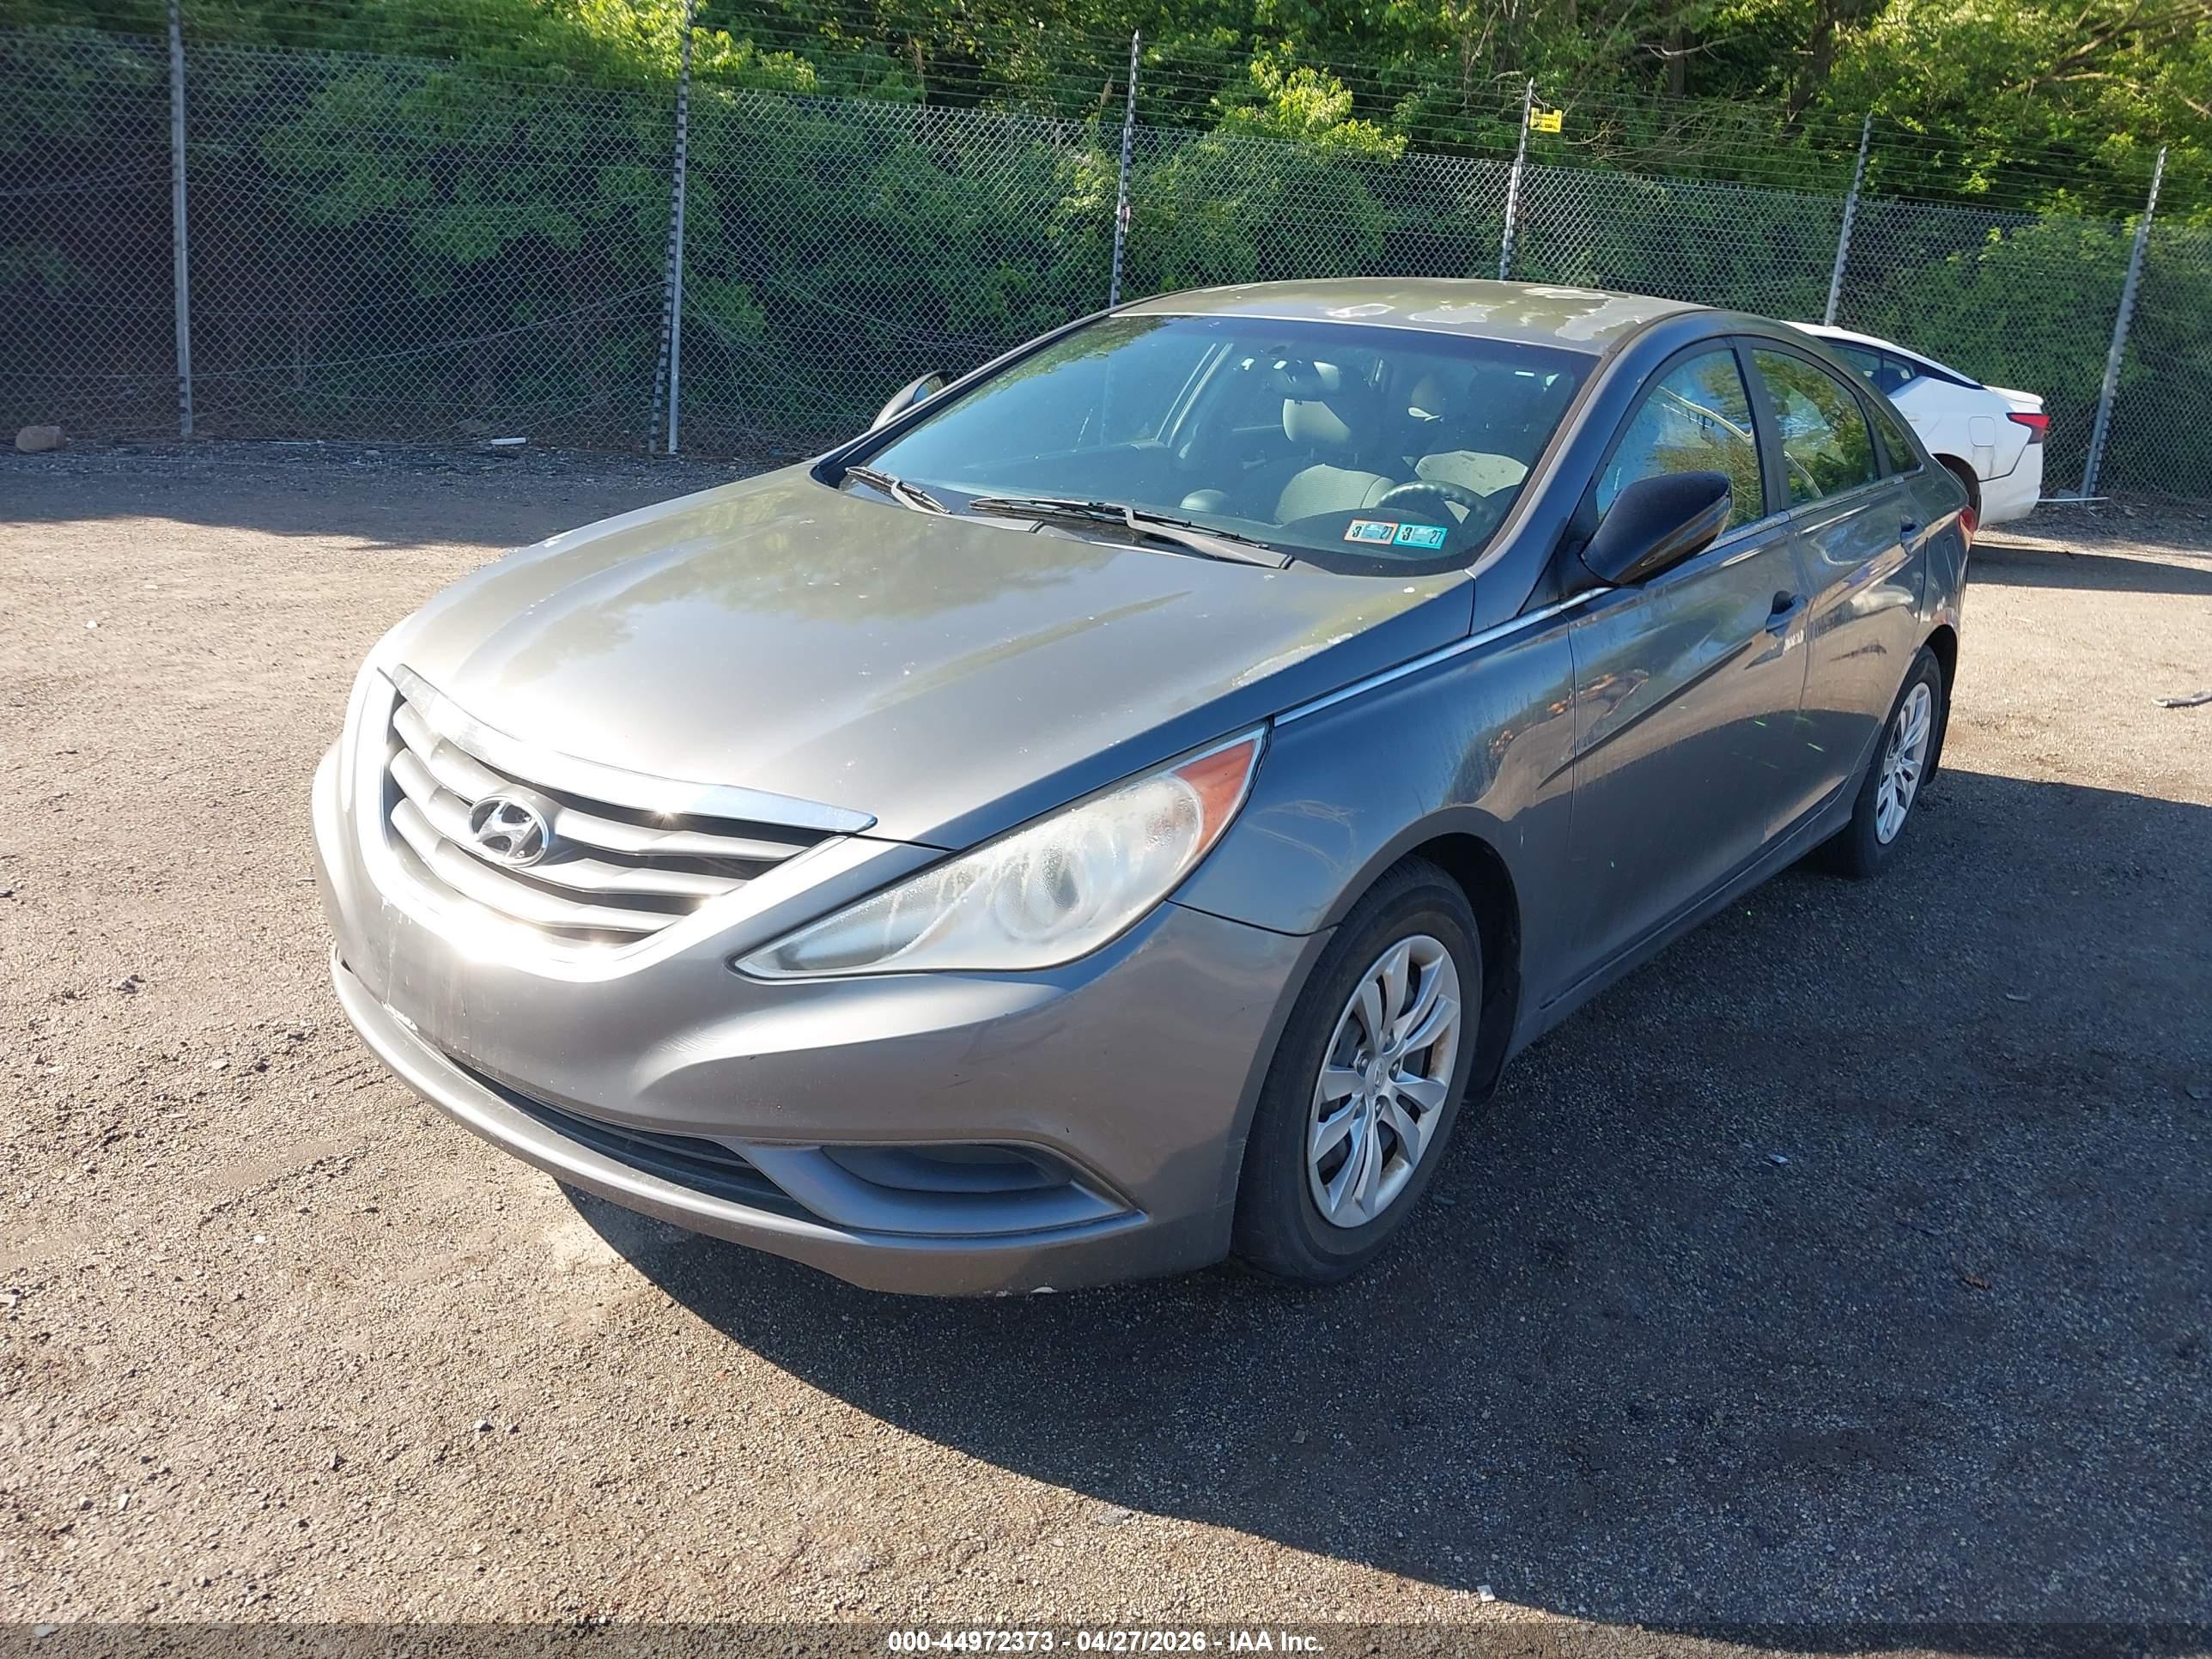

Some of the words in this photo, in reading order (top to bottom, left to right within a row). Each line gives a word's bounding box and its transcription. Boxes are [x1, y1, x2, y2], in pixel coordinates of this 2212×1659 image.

[1352, 526, 1362, 538] 3
[1380, 526, 1394, 539] 27
[1402, 527, 1413, 541] 3
[1429, 530, 1443, 544] 27
